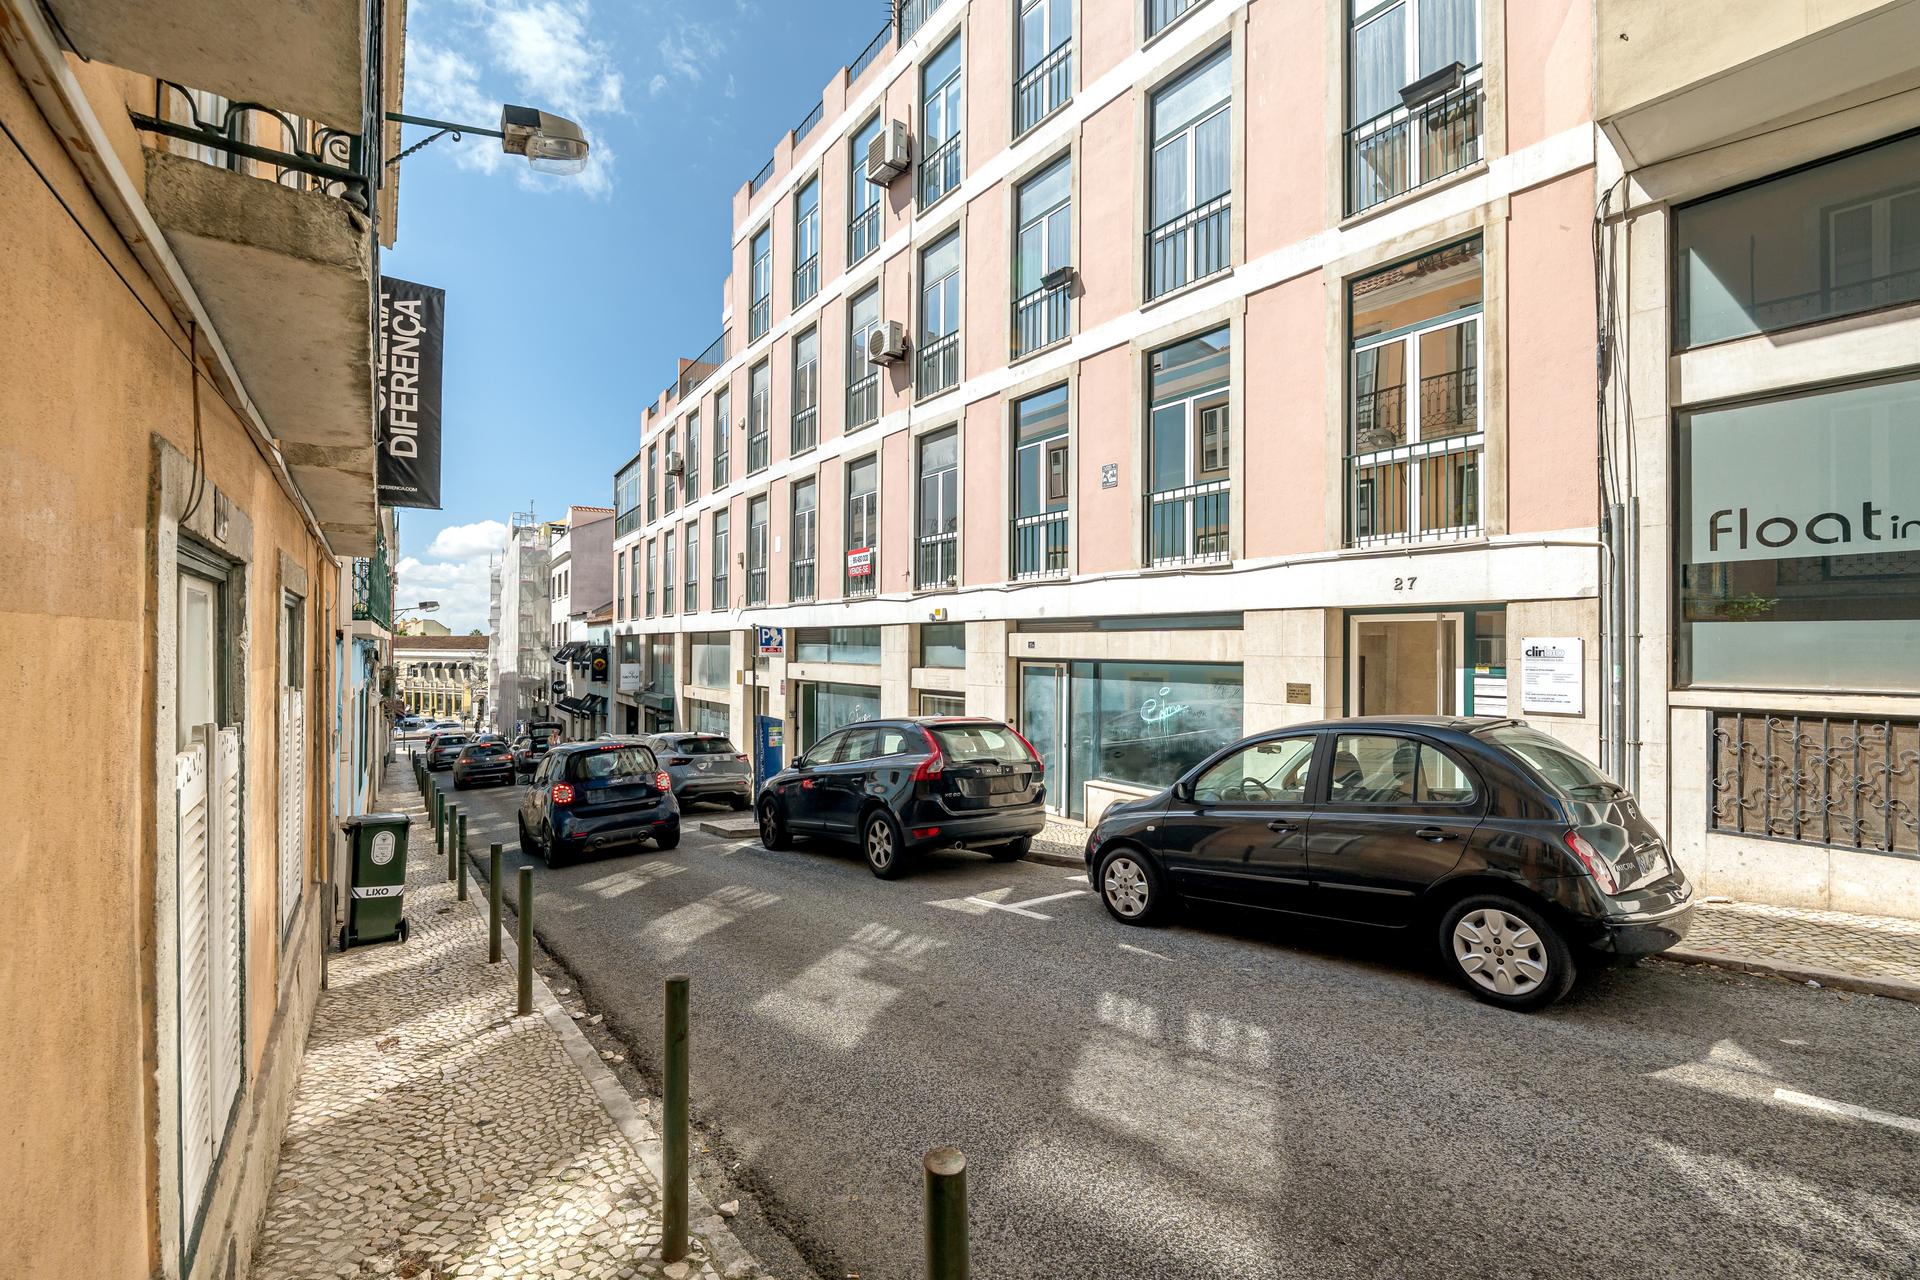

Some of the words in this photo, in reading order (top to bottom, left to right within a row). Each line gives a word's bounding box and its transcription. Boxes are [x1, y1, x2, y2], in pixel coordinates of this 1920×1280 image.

[390, 300, 426, 458] DIFERENÇA
[1393, 576, 1418, 591] 27
[761, 628, 771, 644] P
[365, 887, 389, 897] LIXO
